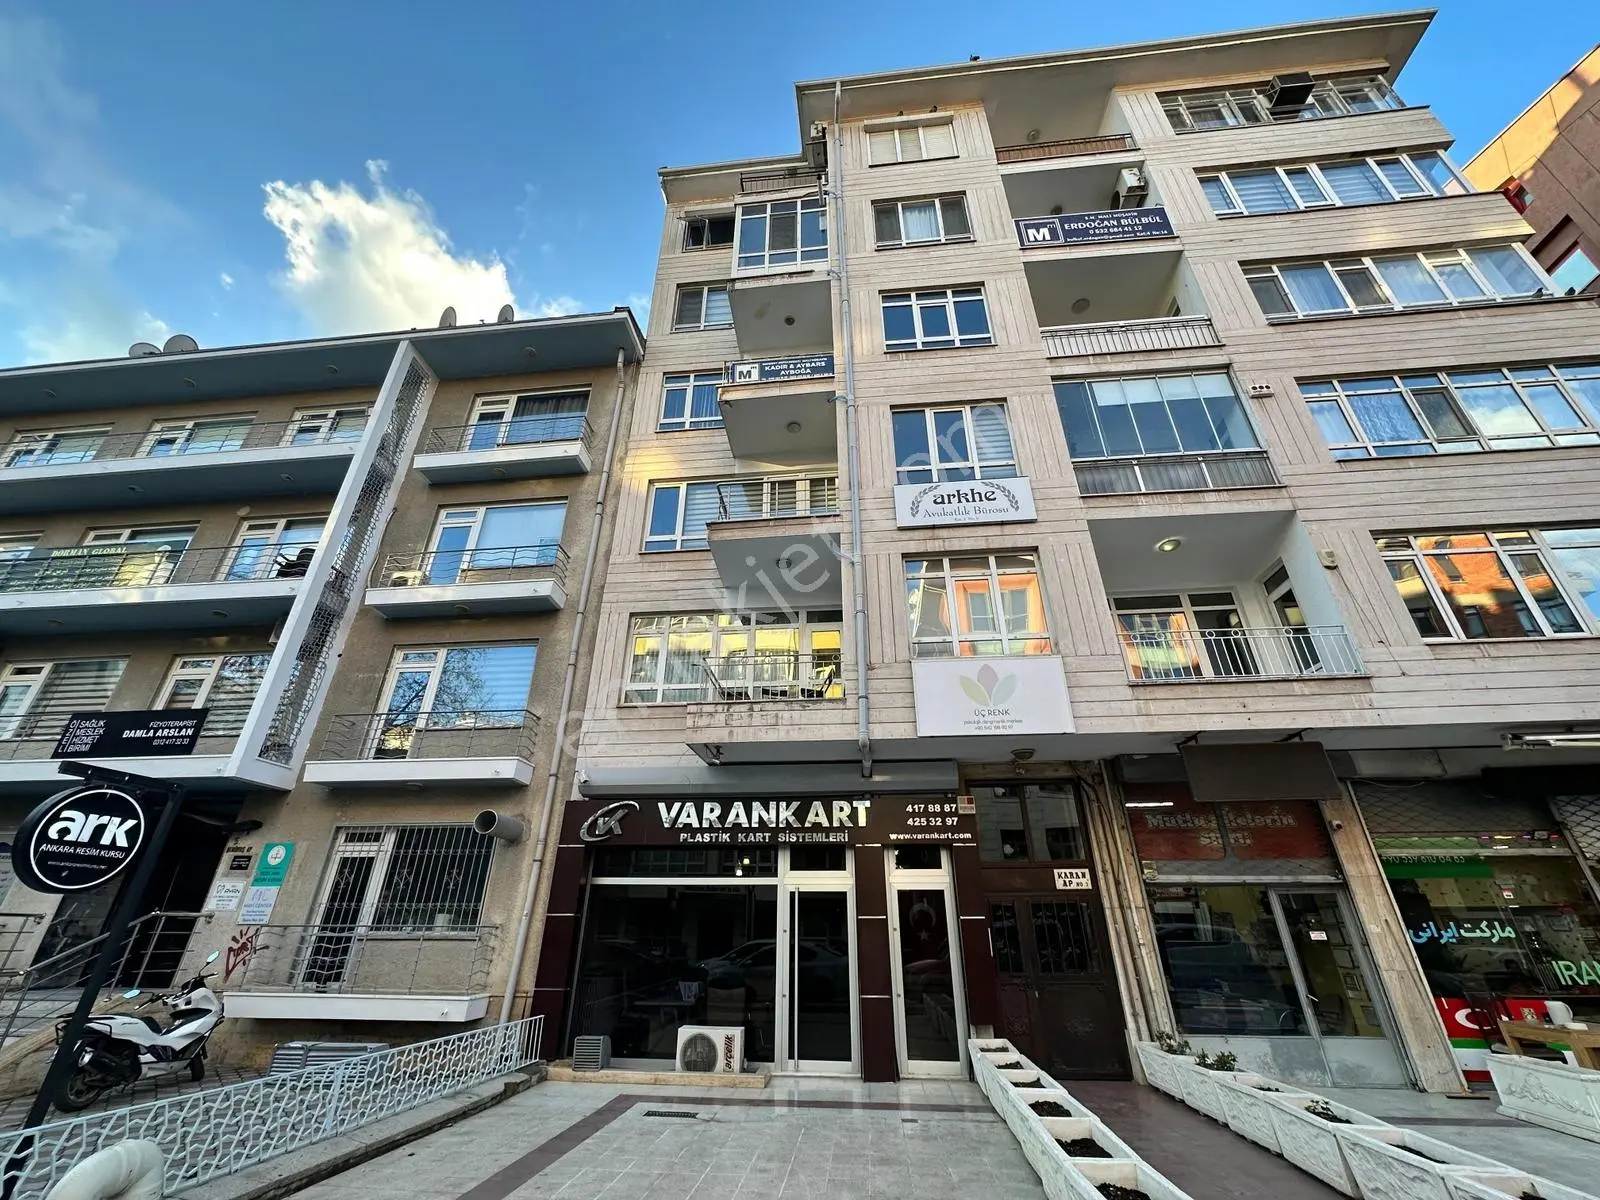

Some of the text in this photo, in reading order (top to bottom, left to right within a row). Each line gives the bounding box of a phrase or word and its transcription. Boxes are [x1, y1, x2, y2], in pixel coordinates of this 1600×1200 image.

[1064, 215, 1163, 230] ERDOĞAN BÜLBÜL
[780, 368, 811, 376] AYBOĞA
[933, 488, 997, 505] arkhe
[923, 505, 1009, 518] Avukatlık Bürosu
[92, 547, 127, 555] GLOBAL
[987, 708, 1010, 717] RENK
[79, 719, 198, 728] SAĞLIK FİZYOTERAPİST
[75, 728, 105, 736] MESLEK
[122, 728, 194, 739] DAMLA ARSLAN
[906, 803, 925, 813] 417
[928, 803, 941, 812] 88
[944, 803, 957, 812] 87
[657, 800, 871, 829] VARANKART
[907, 817, 958, 826] 425 32 97
[48, 810, 139, 847] ark
[680, 830, 849, 842] PLASTİK KART SİSTEMLERİ
[889, 832, 972, 841] www.varankart.com
[40, 843, 126, 859] ANKARA RESİM KURSU
[1057, 871, 1087, 879] KARAN
[1408, 921, 1516, 945] مارکت ایرانی
[723, 1033, 734, 1070] arçelik
